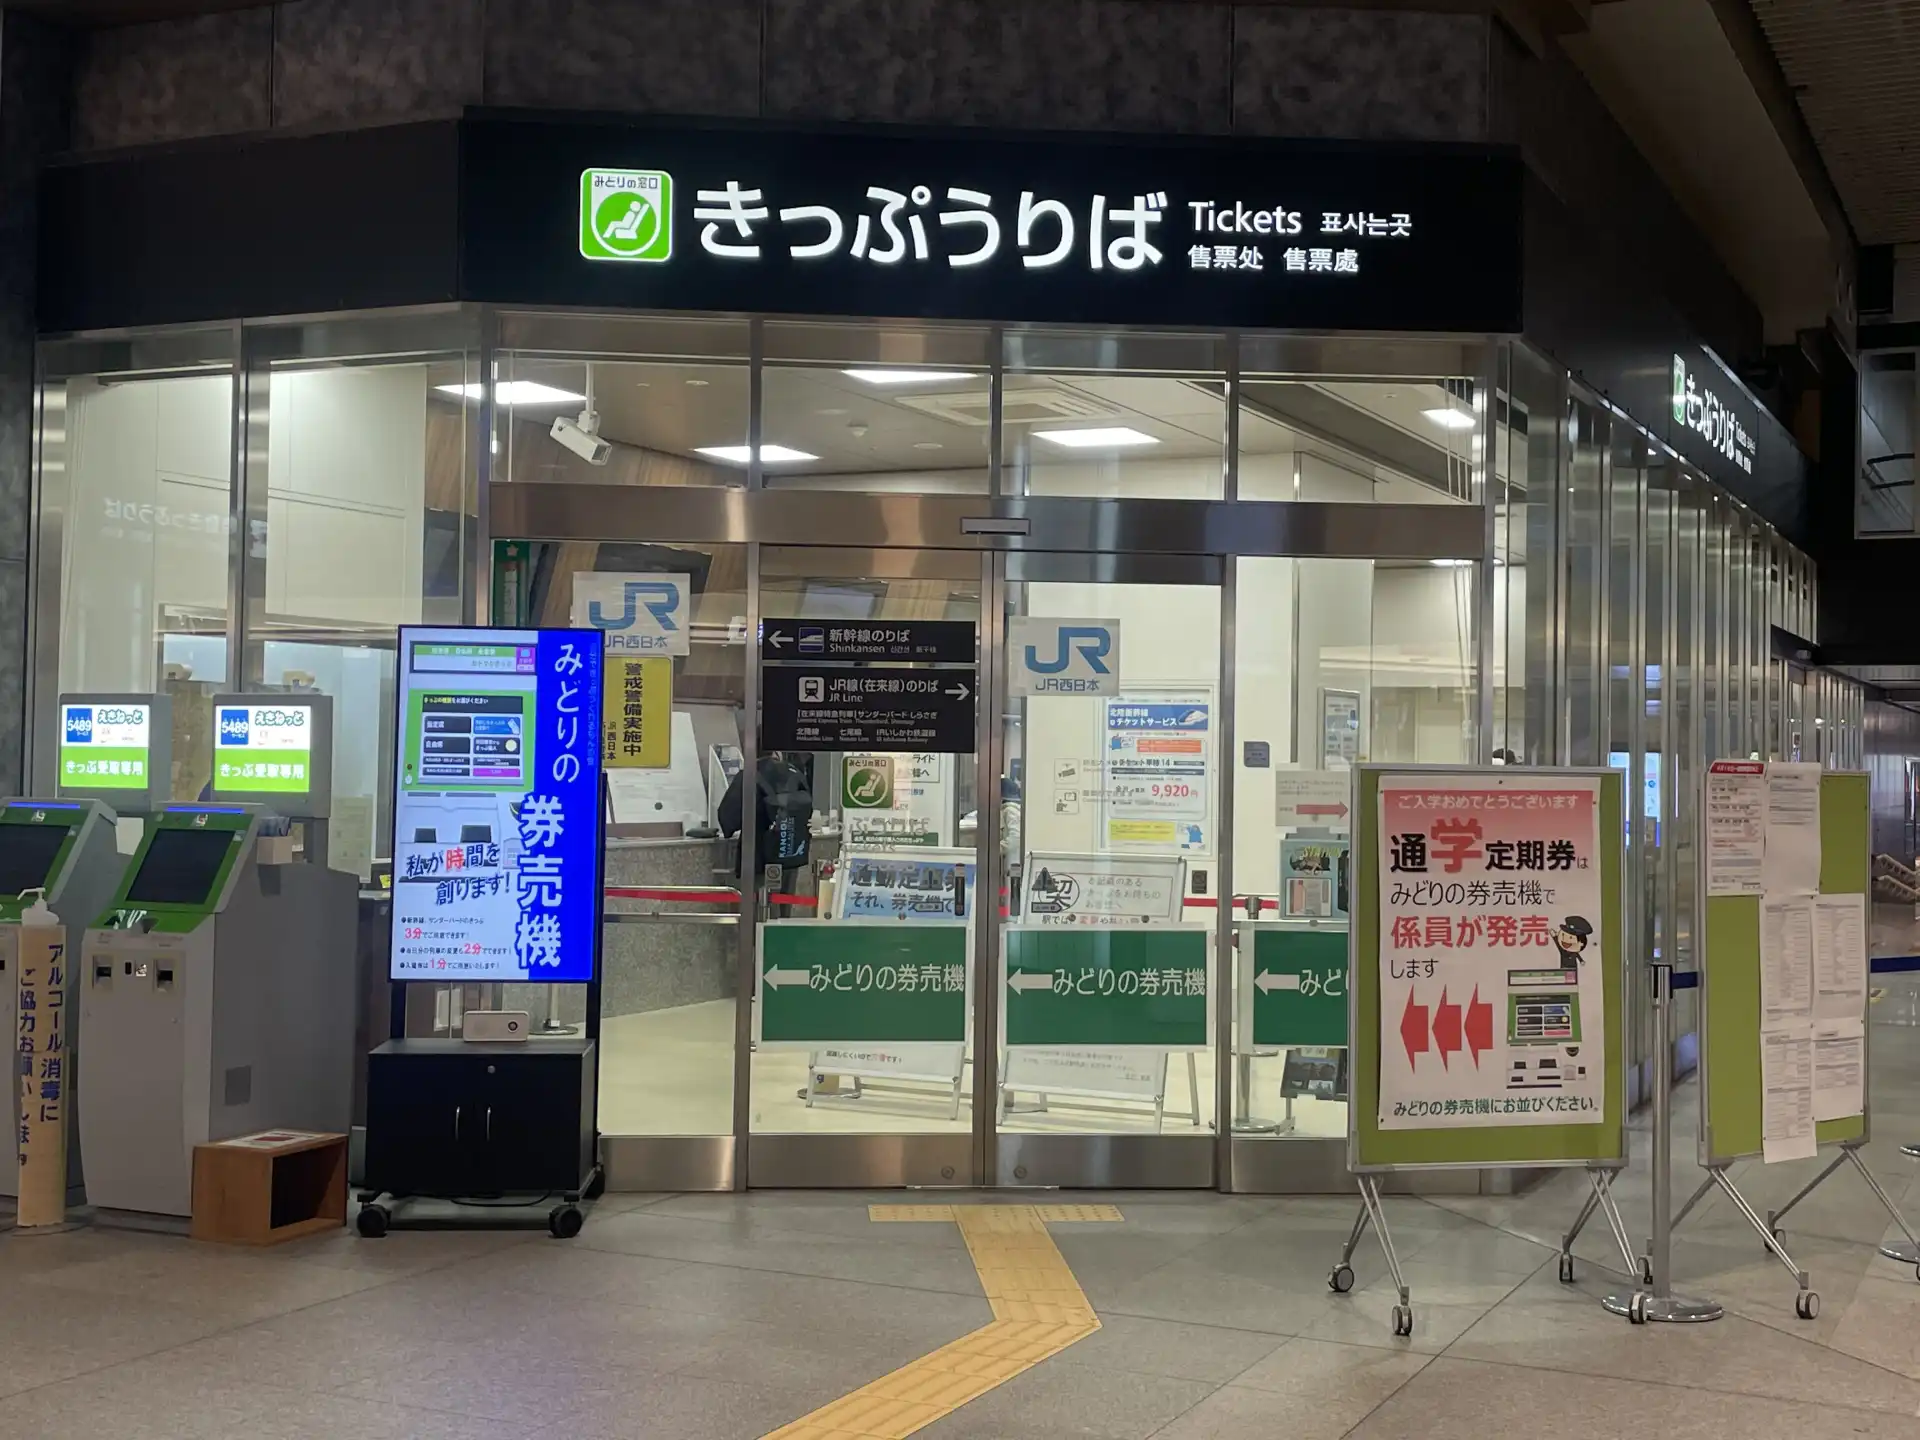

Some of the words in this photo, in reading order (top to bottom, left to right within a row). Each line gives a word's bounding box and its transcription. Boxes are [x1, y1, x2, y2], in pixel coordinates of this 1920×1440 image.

[594, 175, 658, 189] みどりの窓口
[693, 181, 1168, 269] きっぷうりば
[1188, 200, 1302, 235] Tickets
[1320, 211, 1412, 237] 표사는곳
[1187, 244, 1264, 270] 售票处
[1283, 247, 1359, 273] 售票處
[589, 582, 680, 630] JR
[603, 635, 668, 649] JR西日本
[829, 629, 910, 643] 新幹線のりば
[829, 643, 886, 654] Shinkansen
[1025, 627, 1111, 674] JR
[829, 678, 940, 693] JR線(在来線)のりば
[1035, 678, 1100, 692] JR西日本
[829, 692, 841, 703] JR
[843, 692, 864, 703] Line
[97, 708, 143, 725] えきねっと
[254, 710, 304, 726] えきねっと
[552, 643, 583, 783] みどりの
[623, 662, 643, 757] 警戒警備実施中
[1109, 708, 1149, 718] 北陸新幹線
[66, 719, 92, 732] 5489
[222, 721, 249, 734] 5489
[1109, 717, 1178, 728] eチケットサービス
[66, 760, 143, 776] きっぷ受取専用
[220, 763, 304, 779] きっぷ受取専用
[849, 759, 887, 767] みどりの窓口
[1151, 784, 1190, 799] 9,920
[1399, 794, 1579, 811] ご入学おめでとうございます
[779, 817, 787, 858] KANGOL
[1390, 817, 1589, 873] 通学定期券は
[406, 842, 500, 878] 私が時間を
[436, 871, 510, 905] 創ります!
[517, 795, 565, 968] 券売機
[1390, 880, 1556, 906] みどりの券売機で
[1391, 915, 1549, 949] 係員が発売
[809, 963, 966, 993] みどりの券売機
[1390, 959, 1439, 979] します
[1053, 967, 1207, 997] みどりの券売機
[1300, 968, 1349, 997] みど
[40, 943, 64, 1122] アルコール消毒に
[1393, 1096, 1599, 1117] みどりの券売機にお並びください。
